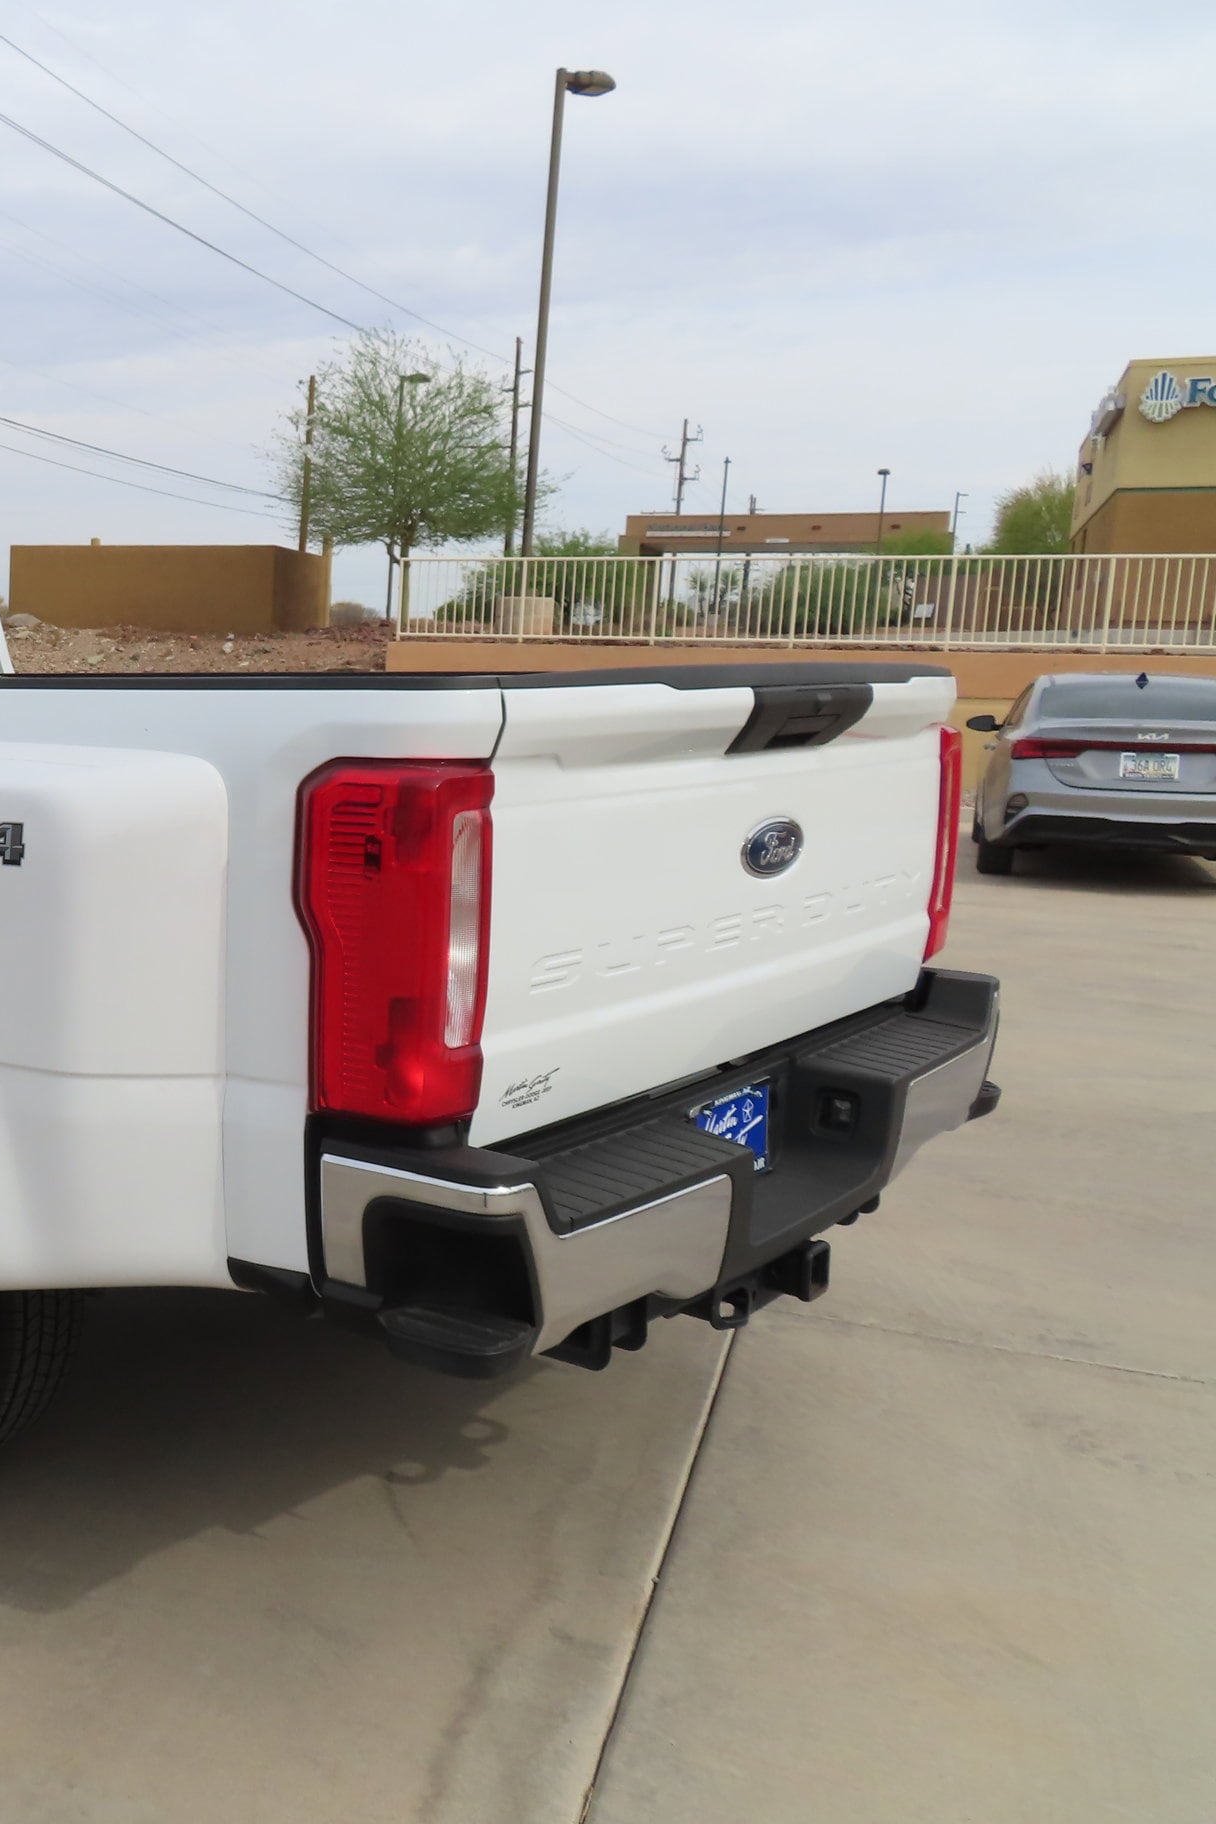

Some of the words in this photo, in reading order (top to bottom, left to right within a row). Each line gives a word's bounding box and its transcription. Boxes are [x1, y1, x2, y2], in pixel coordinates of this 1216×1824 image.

[760, 831, 796, 866] Ford
[530, 903, 788, 995] SUPER
[802, 870, 922, 928] DUTY
